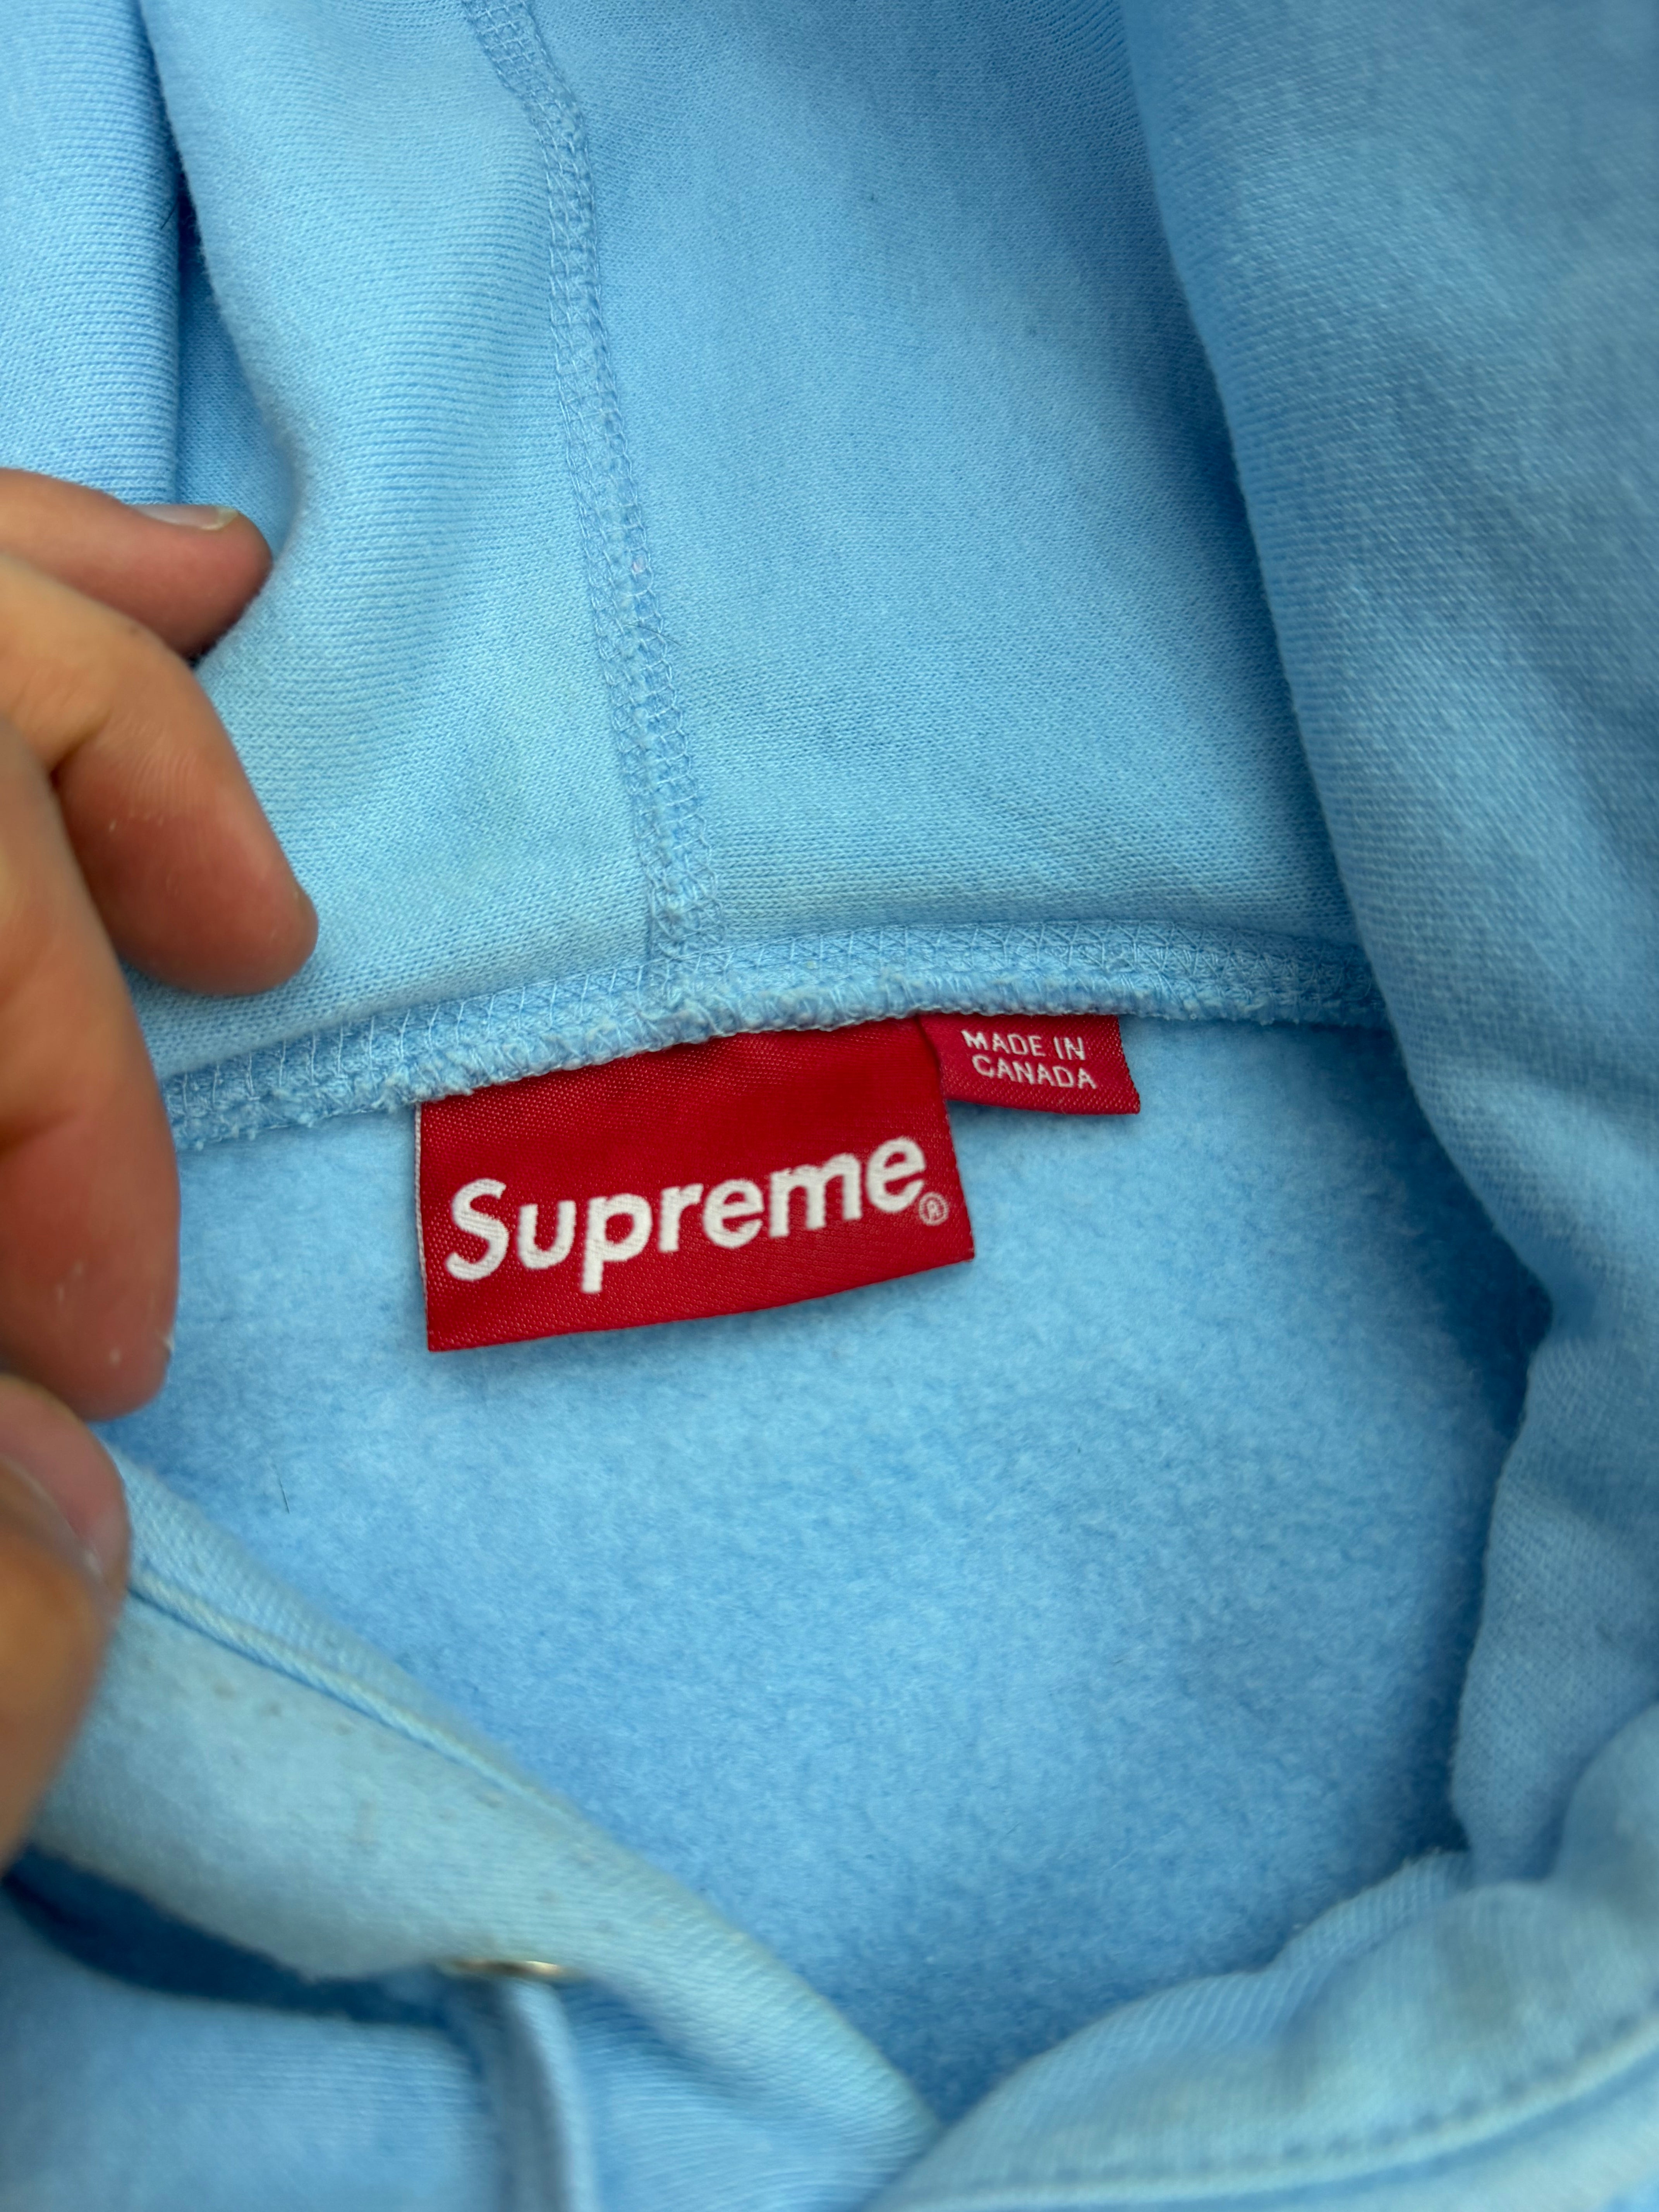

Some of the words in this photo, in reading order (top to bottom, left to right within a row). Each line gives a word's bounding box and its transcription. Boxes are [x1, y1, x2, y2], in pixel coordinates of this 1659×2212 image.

[961, 1030, 1046, 1057] MADE
[1053, 1036, 1085, 1061] IN
[972, 1054, 1097, 1089] CANADA
